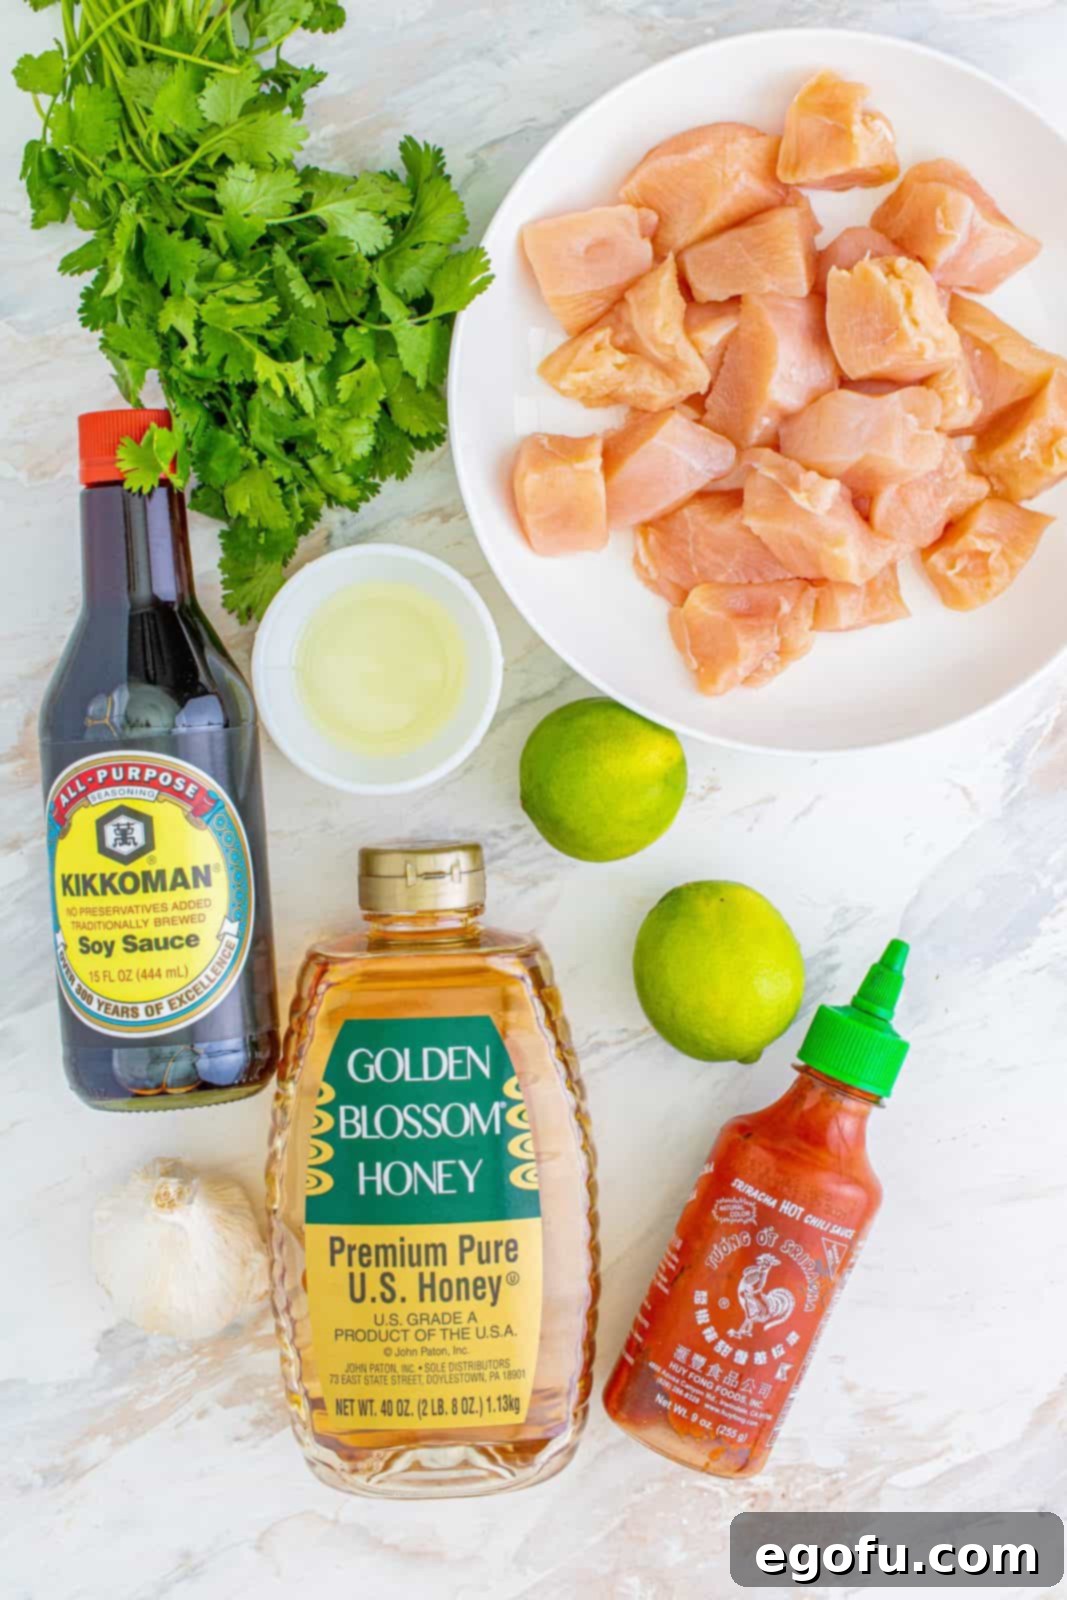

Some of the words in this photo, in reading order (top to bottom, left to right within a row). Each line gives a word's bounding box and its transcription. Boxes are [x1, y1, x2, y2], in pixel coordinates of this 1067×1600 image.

[59, 766, 199, 807] ALL-PURPOSE
[90, 787, 156, 802] SEASONING
[61, 864, 213, 897] KIKKOMAN
[66, 907, 77, 917] NO
[79, 901, 169, 917] PRESERVATIVES
[171, 898, 212, 912] ADDED
[71, 918, 149, 931] TRADITIONALLY
[153, 913, 206, 928] BREWED
[78, 935, 115, 958] Soy
[122, 932, 200, 954] Sauce
[75, 983, 94, 1006] 300
[96, 998, 140, 1019] YEARS
[146, 999, 164, 1018] OF
[168, 940, 236, 1011] EXCELLENCE
[89, 970, 100, 982] 15
[102, 969, 115, 982] FL
[117, 968, 133, 982] OZ
[136, 967, 162, 983] (444
[165, 965, 189, 980] mL)
[347, 1045, 491, 1084] GOLDEN
[338, 1101, 501, 1140] BLOSSOM
[358, 1158, 483, 1196] HONEY
[731, 1177, 778, 1208] SRIRACHA
[778, 1199, 806, 1221] HOT
[803, 1213, 833, 1233] CHILI
[828, 1224, 857, 1240] SAUCE
[329, 1235, 447, 1268] Premium
[458, 1234, 519, 1266] Pure
[348, 1271, 407, 1304] U.S.
[418, 1271, 502, 1307] Honey
[373, 1313, 403, 1326] U.S.
[406, 1311, 462, 1326] GRADE
[467, 1311, 478, 1323] A
[334, 1328, 409, 1342] PRODUCT
[414, 1328, 436, 1342] OF
[441, 1326, 470, 1340] THE
[475, 1324, 518, 1339] U.S.A.
[394, 1346, 418, 1357] John
[420, 1346, 450, 1357] Paton,
[452, 1345, 470, 1355] Inc.
[329, 1374, 340, 1385] 73
[341, 1374, 361, 1385] EAST
[364, 1374, 389, 1385] STATE
[489, 1370, 500, 1381] PA
[345, 1363, 367, 1374] JOHN
[424, 1362, 446, 1373] SOLE
[449, 1358, 511, 1372] DISTRIBUTORS
[668, 1361, 688, 1376] HUY
[688, 1371, 714, 1390] FONG
[335, 1398, 356, 1417] NET
[358, 1398, 377, 1416] WT.
[380, 1398, 394, 1416] 40
[396, 1398, 414, 1416] OZ.
[417, 1398, 428, 1420] (2
[431, 1398, 448, 1416] LB.
[451, 1397, 459, 1416] 8
[461, 1396, 483, 1418] OZ.)
[486, 1394, 521, 1415] 1.13kg
[654, 1392, 672, 1410] Net
[690, 1412, 699, 1423] 9
[715, 1424, 738, 1439] (255
